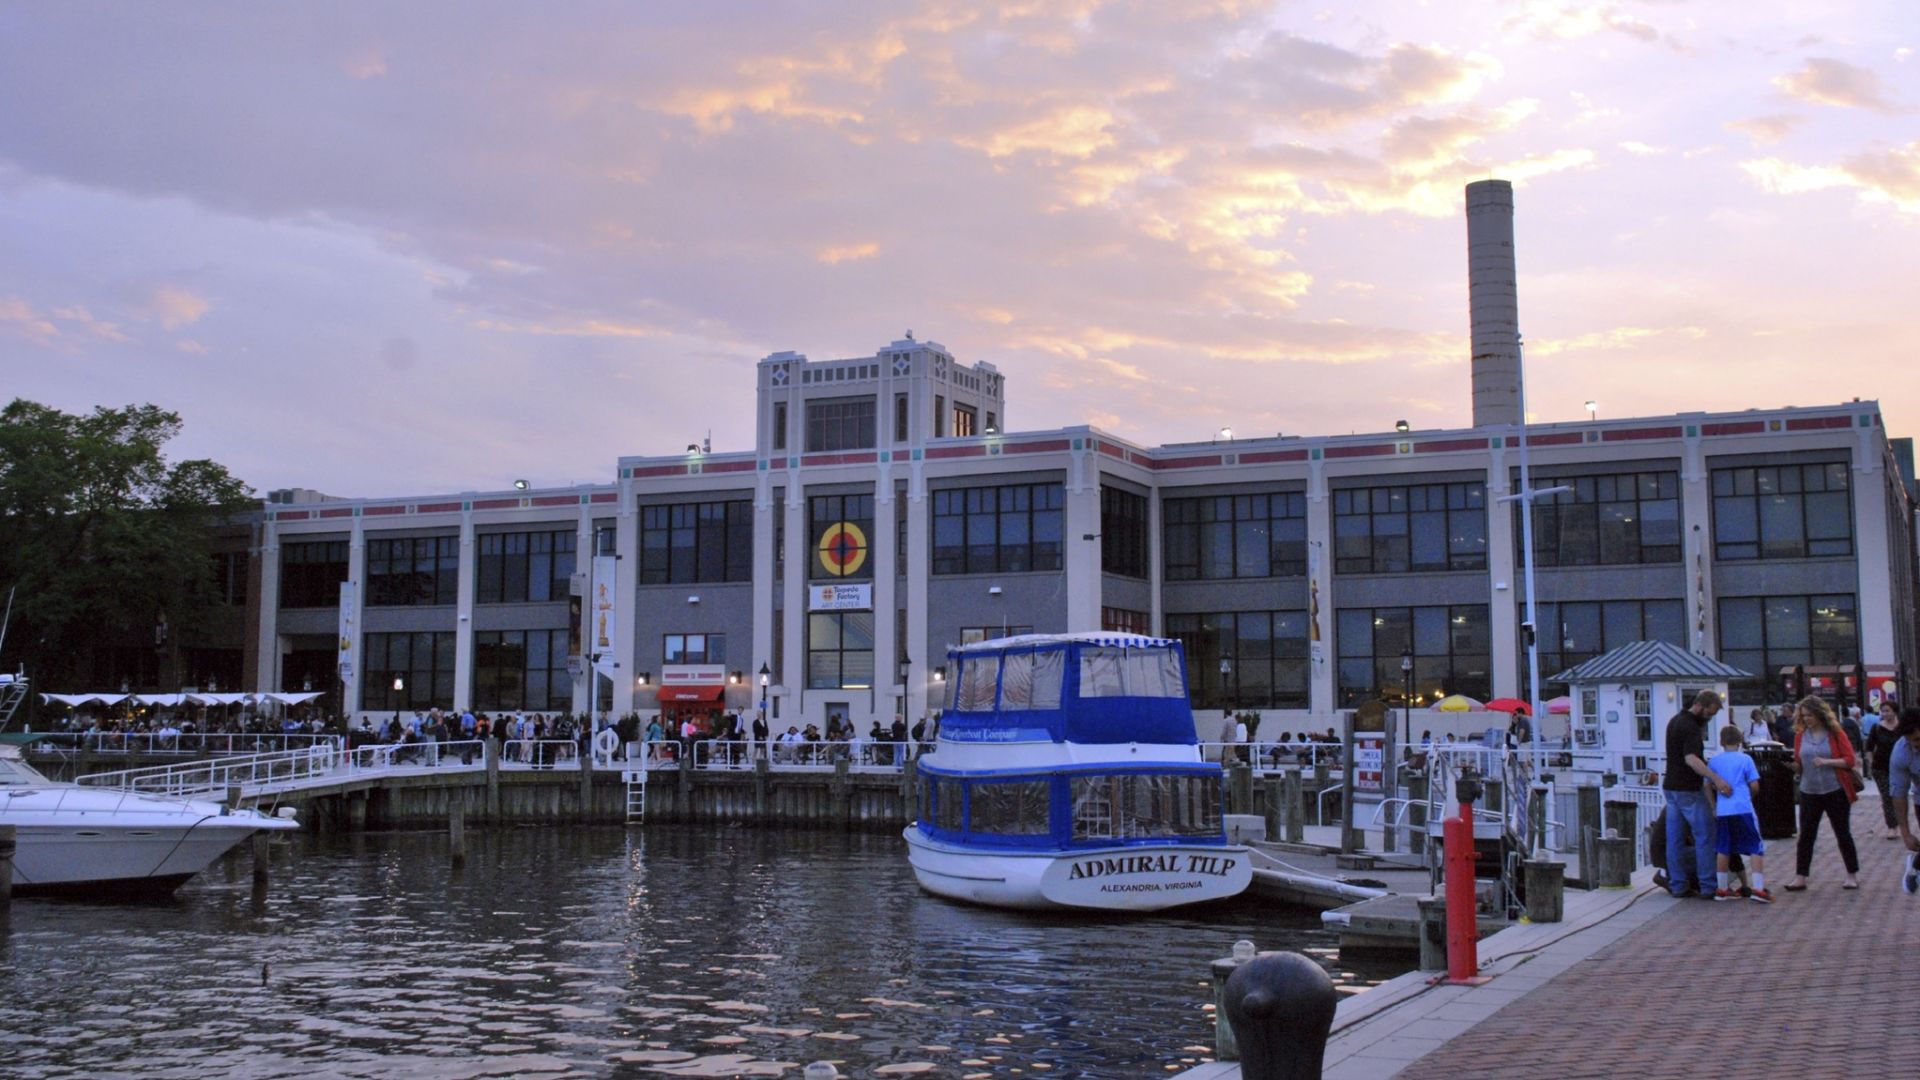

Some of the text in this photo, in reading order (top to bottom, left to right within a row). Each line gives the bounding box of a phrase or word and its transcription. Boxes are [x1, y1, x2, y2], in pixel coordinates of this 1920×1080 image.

[1069, 855, 1236, 879] ADMIRAL TILP
[1165, 881, 1203, 891] VIRGINIA
